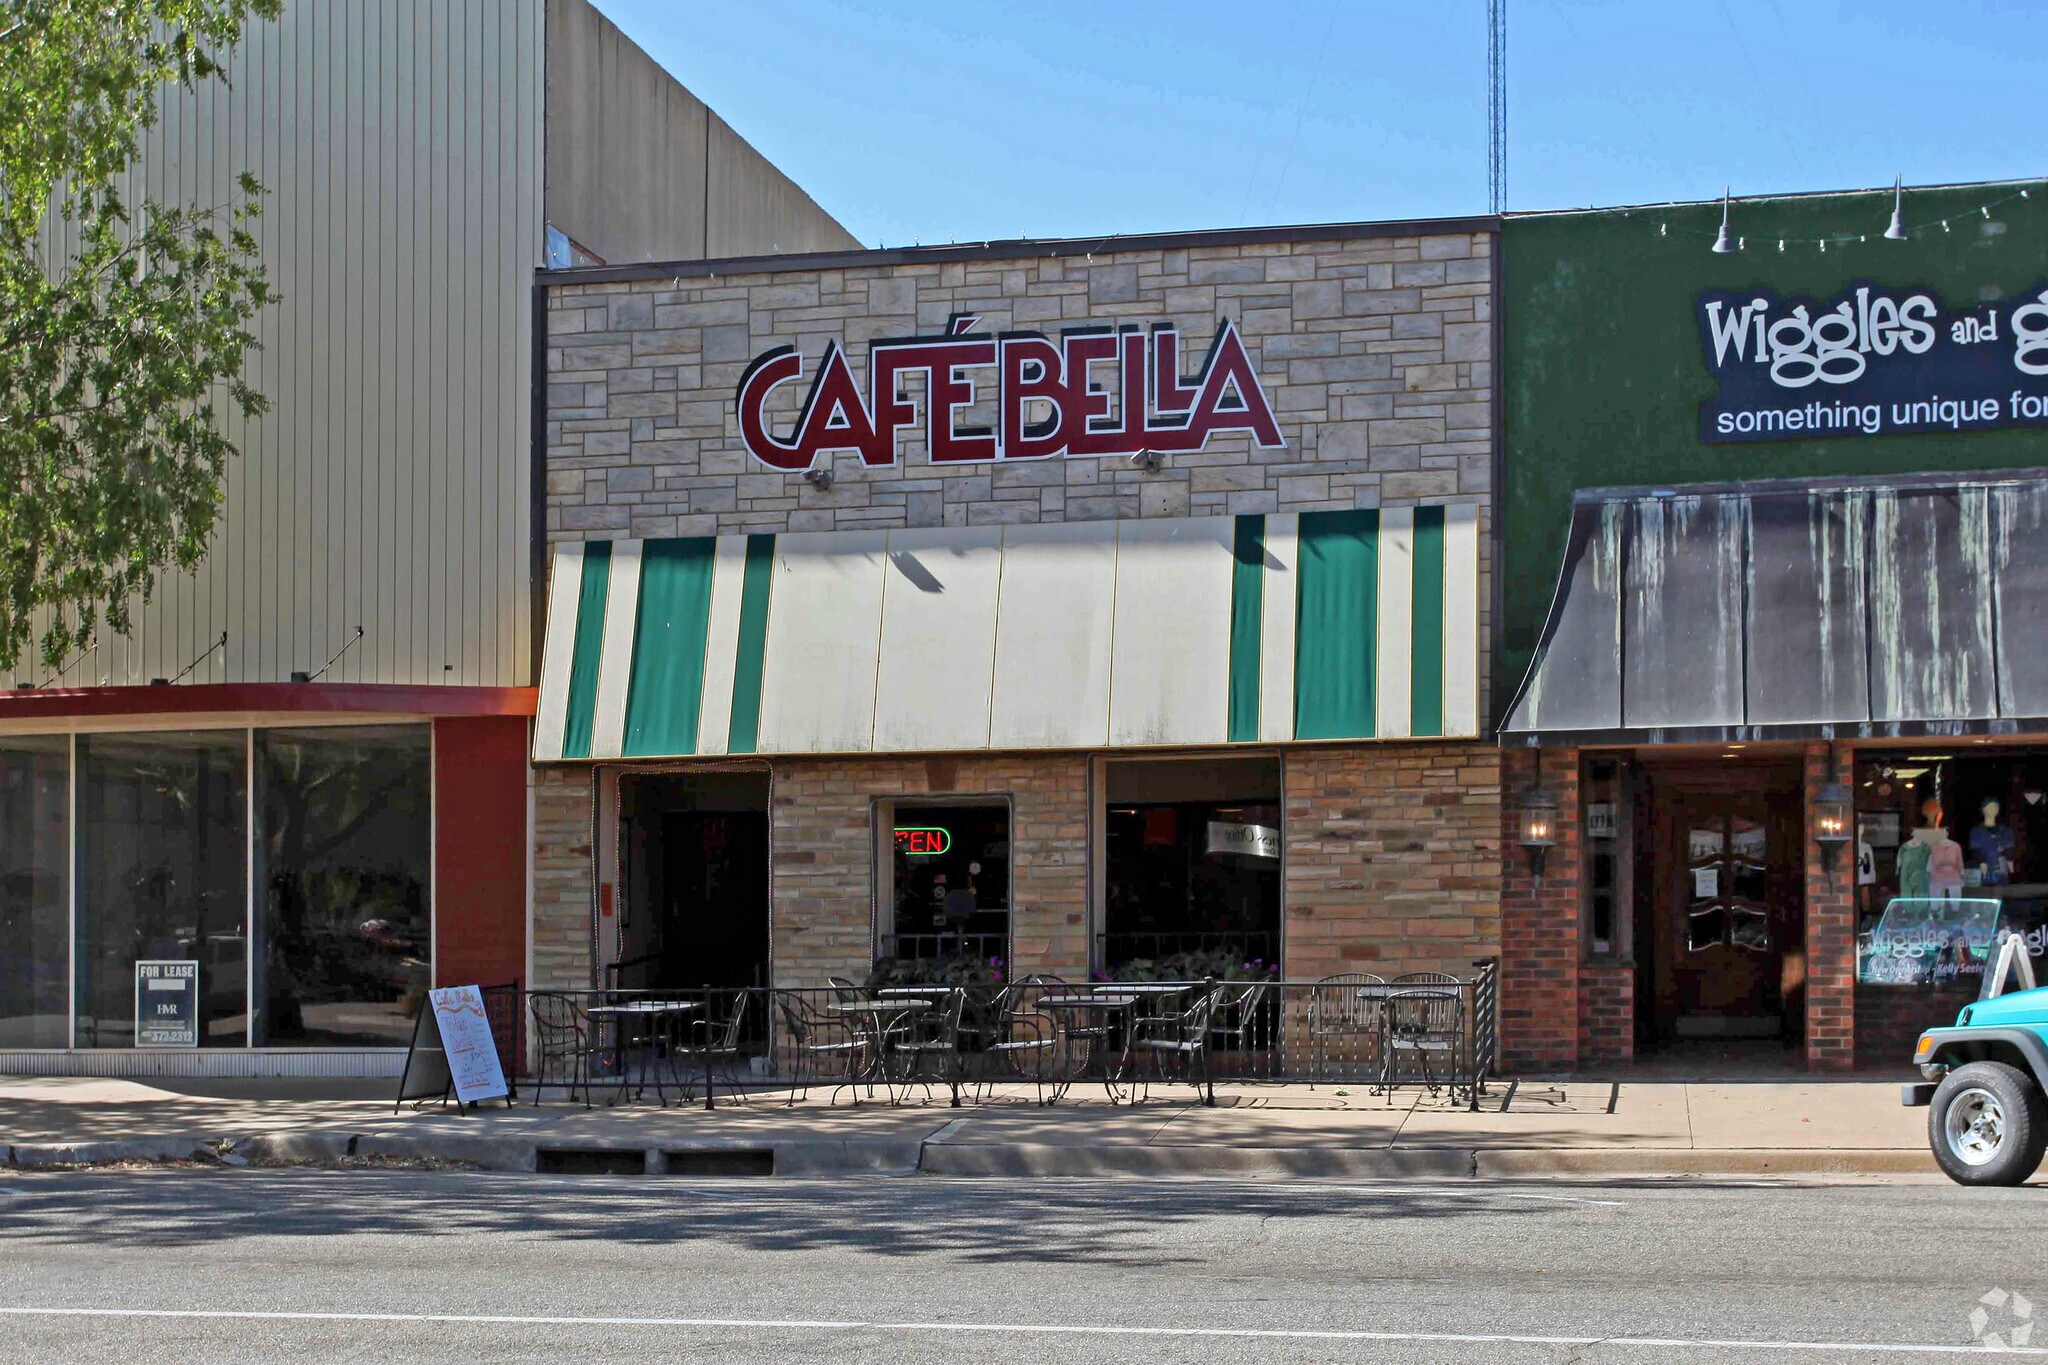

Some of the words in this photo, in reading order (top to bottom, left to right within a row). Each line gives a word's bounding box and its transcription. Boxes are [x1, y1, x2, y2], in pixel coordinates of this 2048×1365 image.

[1705, 287, 1937, 388] Wiggles
[1951, 310, 1998, 344] and
[1717, 401, 1881, 433] something
[1892, 395, 2000, 429] unique
[1870, 924, 1950, 958] Wiggles
[140, 965, 160, 978] FOR
[164, 965, 194, 978] LEASE
[1938, 962, 1959, 976] Kelly
